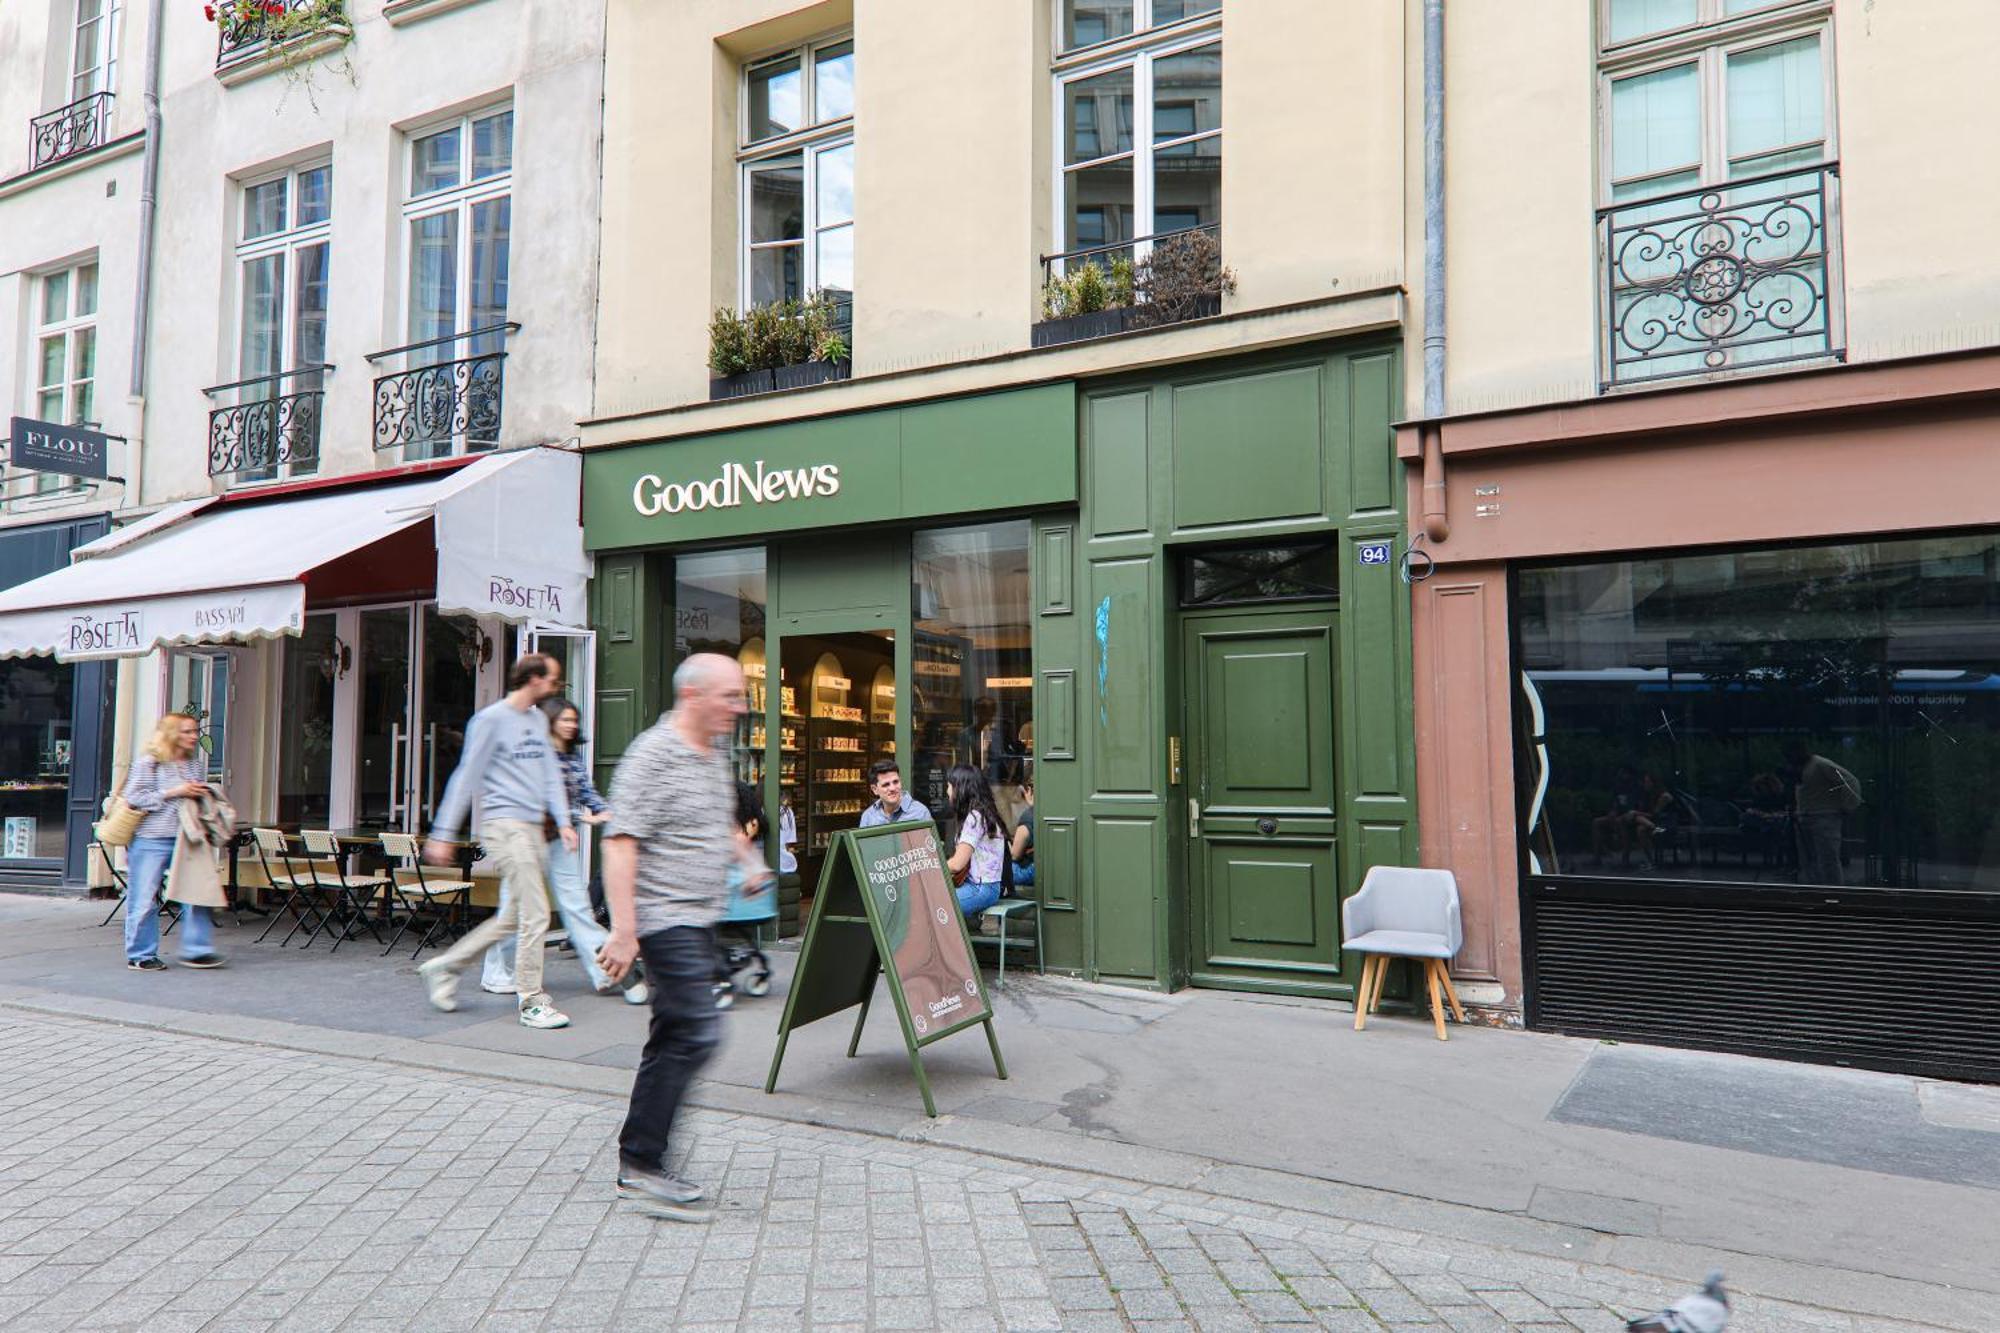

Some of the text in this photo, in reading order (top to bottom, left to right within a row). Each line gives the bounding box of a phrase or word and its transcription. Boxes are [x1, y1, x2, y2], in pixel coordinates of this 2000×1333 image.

[633, 460, 840, 517] GoodNews
[1363, 547, 1385, 562] 94
[490, 575, 562, 613] ROSETTA
[70, 611, 140, 650] ROSETTA
[874, 857, 898, 872] GOOD
[886, 865, 910, 882] GOOD
